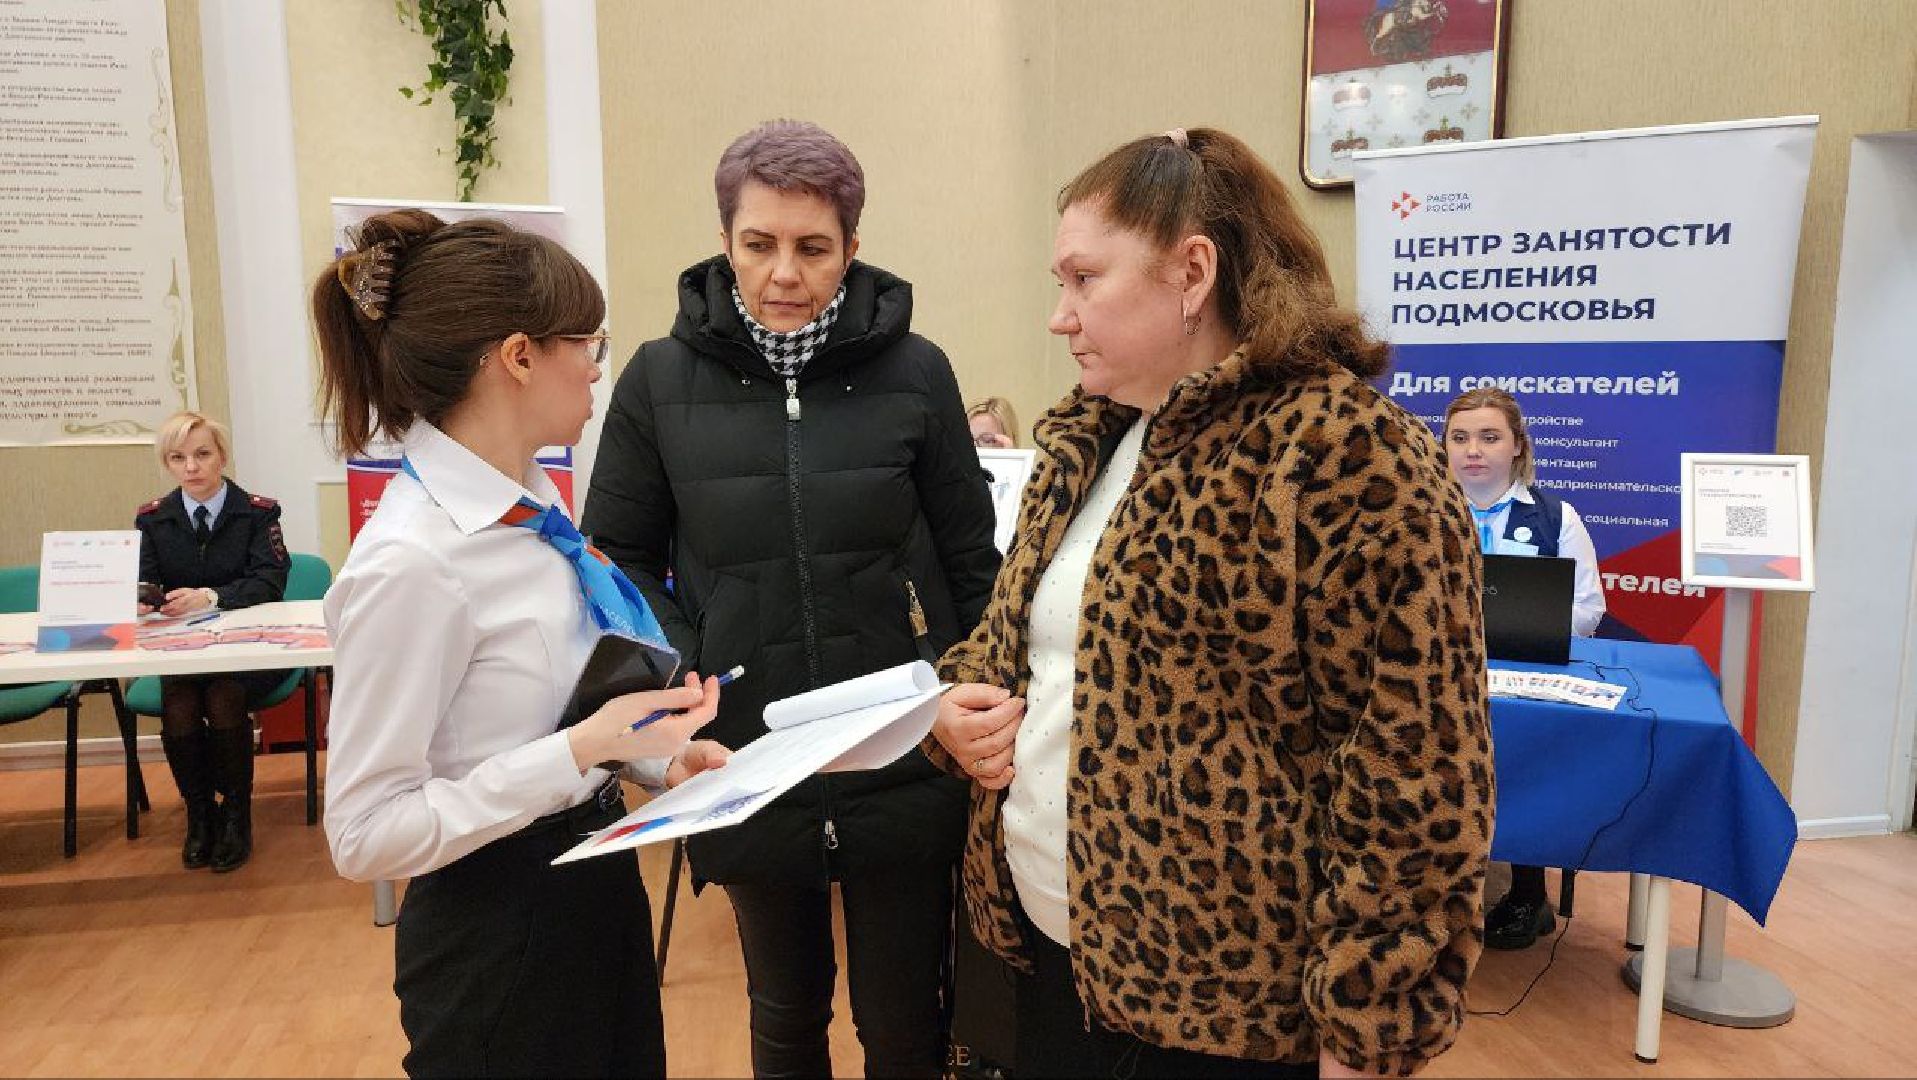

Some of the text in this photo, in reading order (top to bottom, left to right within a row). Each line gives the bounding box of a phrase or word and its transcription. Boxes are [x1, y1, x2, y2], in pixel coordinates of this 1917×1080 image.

[1426, 192, 1470, 203] РАБОТА
[1426, 202, 1472, 213] РОССИИ
[1393, 222, 1733, 263] ЦЕНТР ЗАНЯТОСТИ
[1393, 264, 1598, 292] НАСЕЛЕНИЯ
[1391, 298, 1656, 327] ПОДМОСКОВЬЯ
[1389, 370, 1680, 397] Для соискателей
[1534, 437, 1620, 449] консультант
[1585, 514, 1669, 528] социальная
